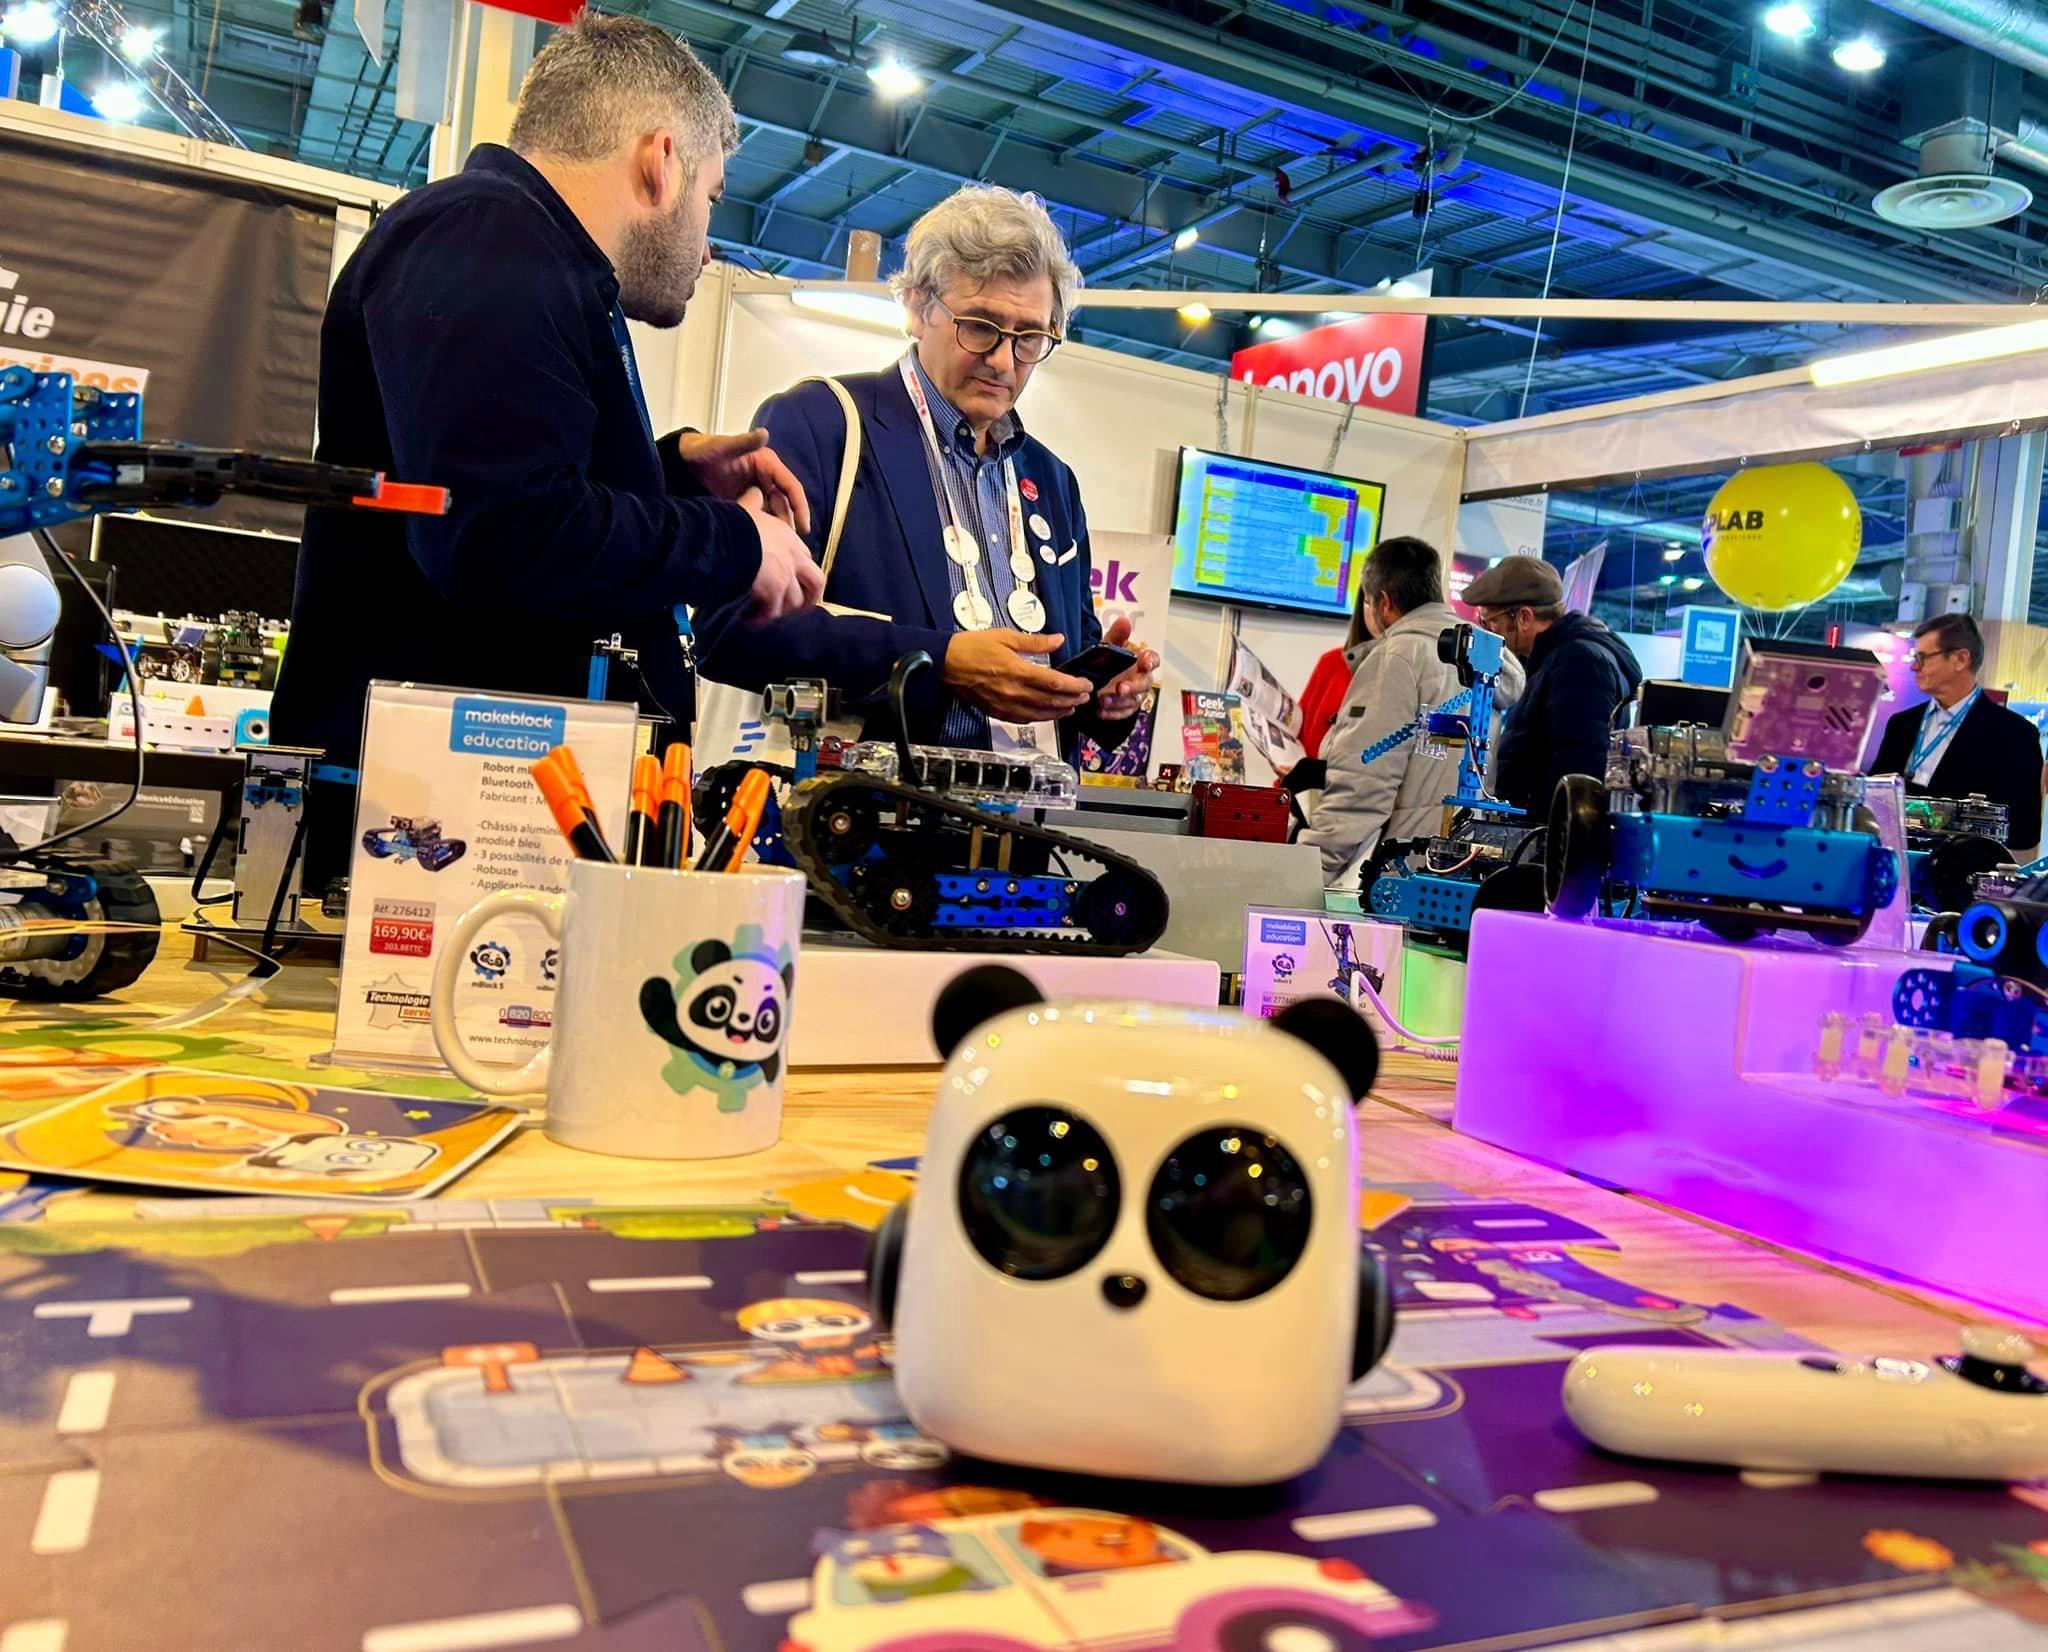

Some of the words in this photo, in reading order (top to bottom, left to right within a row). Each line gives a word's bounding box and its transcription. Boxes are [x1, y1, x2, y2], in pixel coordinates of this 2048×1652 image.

[1198, 695, 1225, 710] Geek
[464, 709, 553, 729] makeblock
[463, 732, 550, 753] education
[483, 762, 515, 774] Robot
[481, 776, 534, 790] Bluetooth
[480, 791, 527, 805] Fabricant
[475, 835, 515, 848] anodisé
[518, 838, 541, 849] bleu
[489, 851, 546, 866] possibilités
[548, 855, 562, 866] de
[391, 905, 431, 918] 276412
[373, 924, 427, 942] 169,90€
[1265, 933, 1301, 943] education
[369, 991, 429, 1006] Technologie
